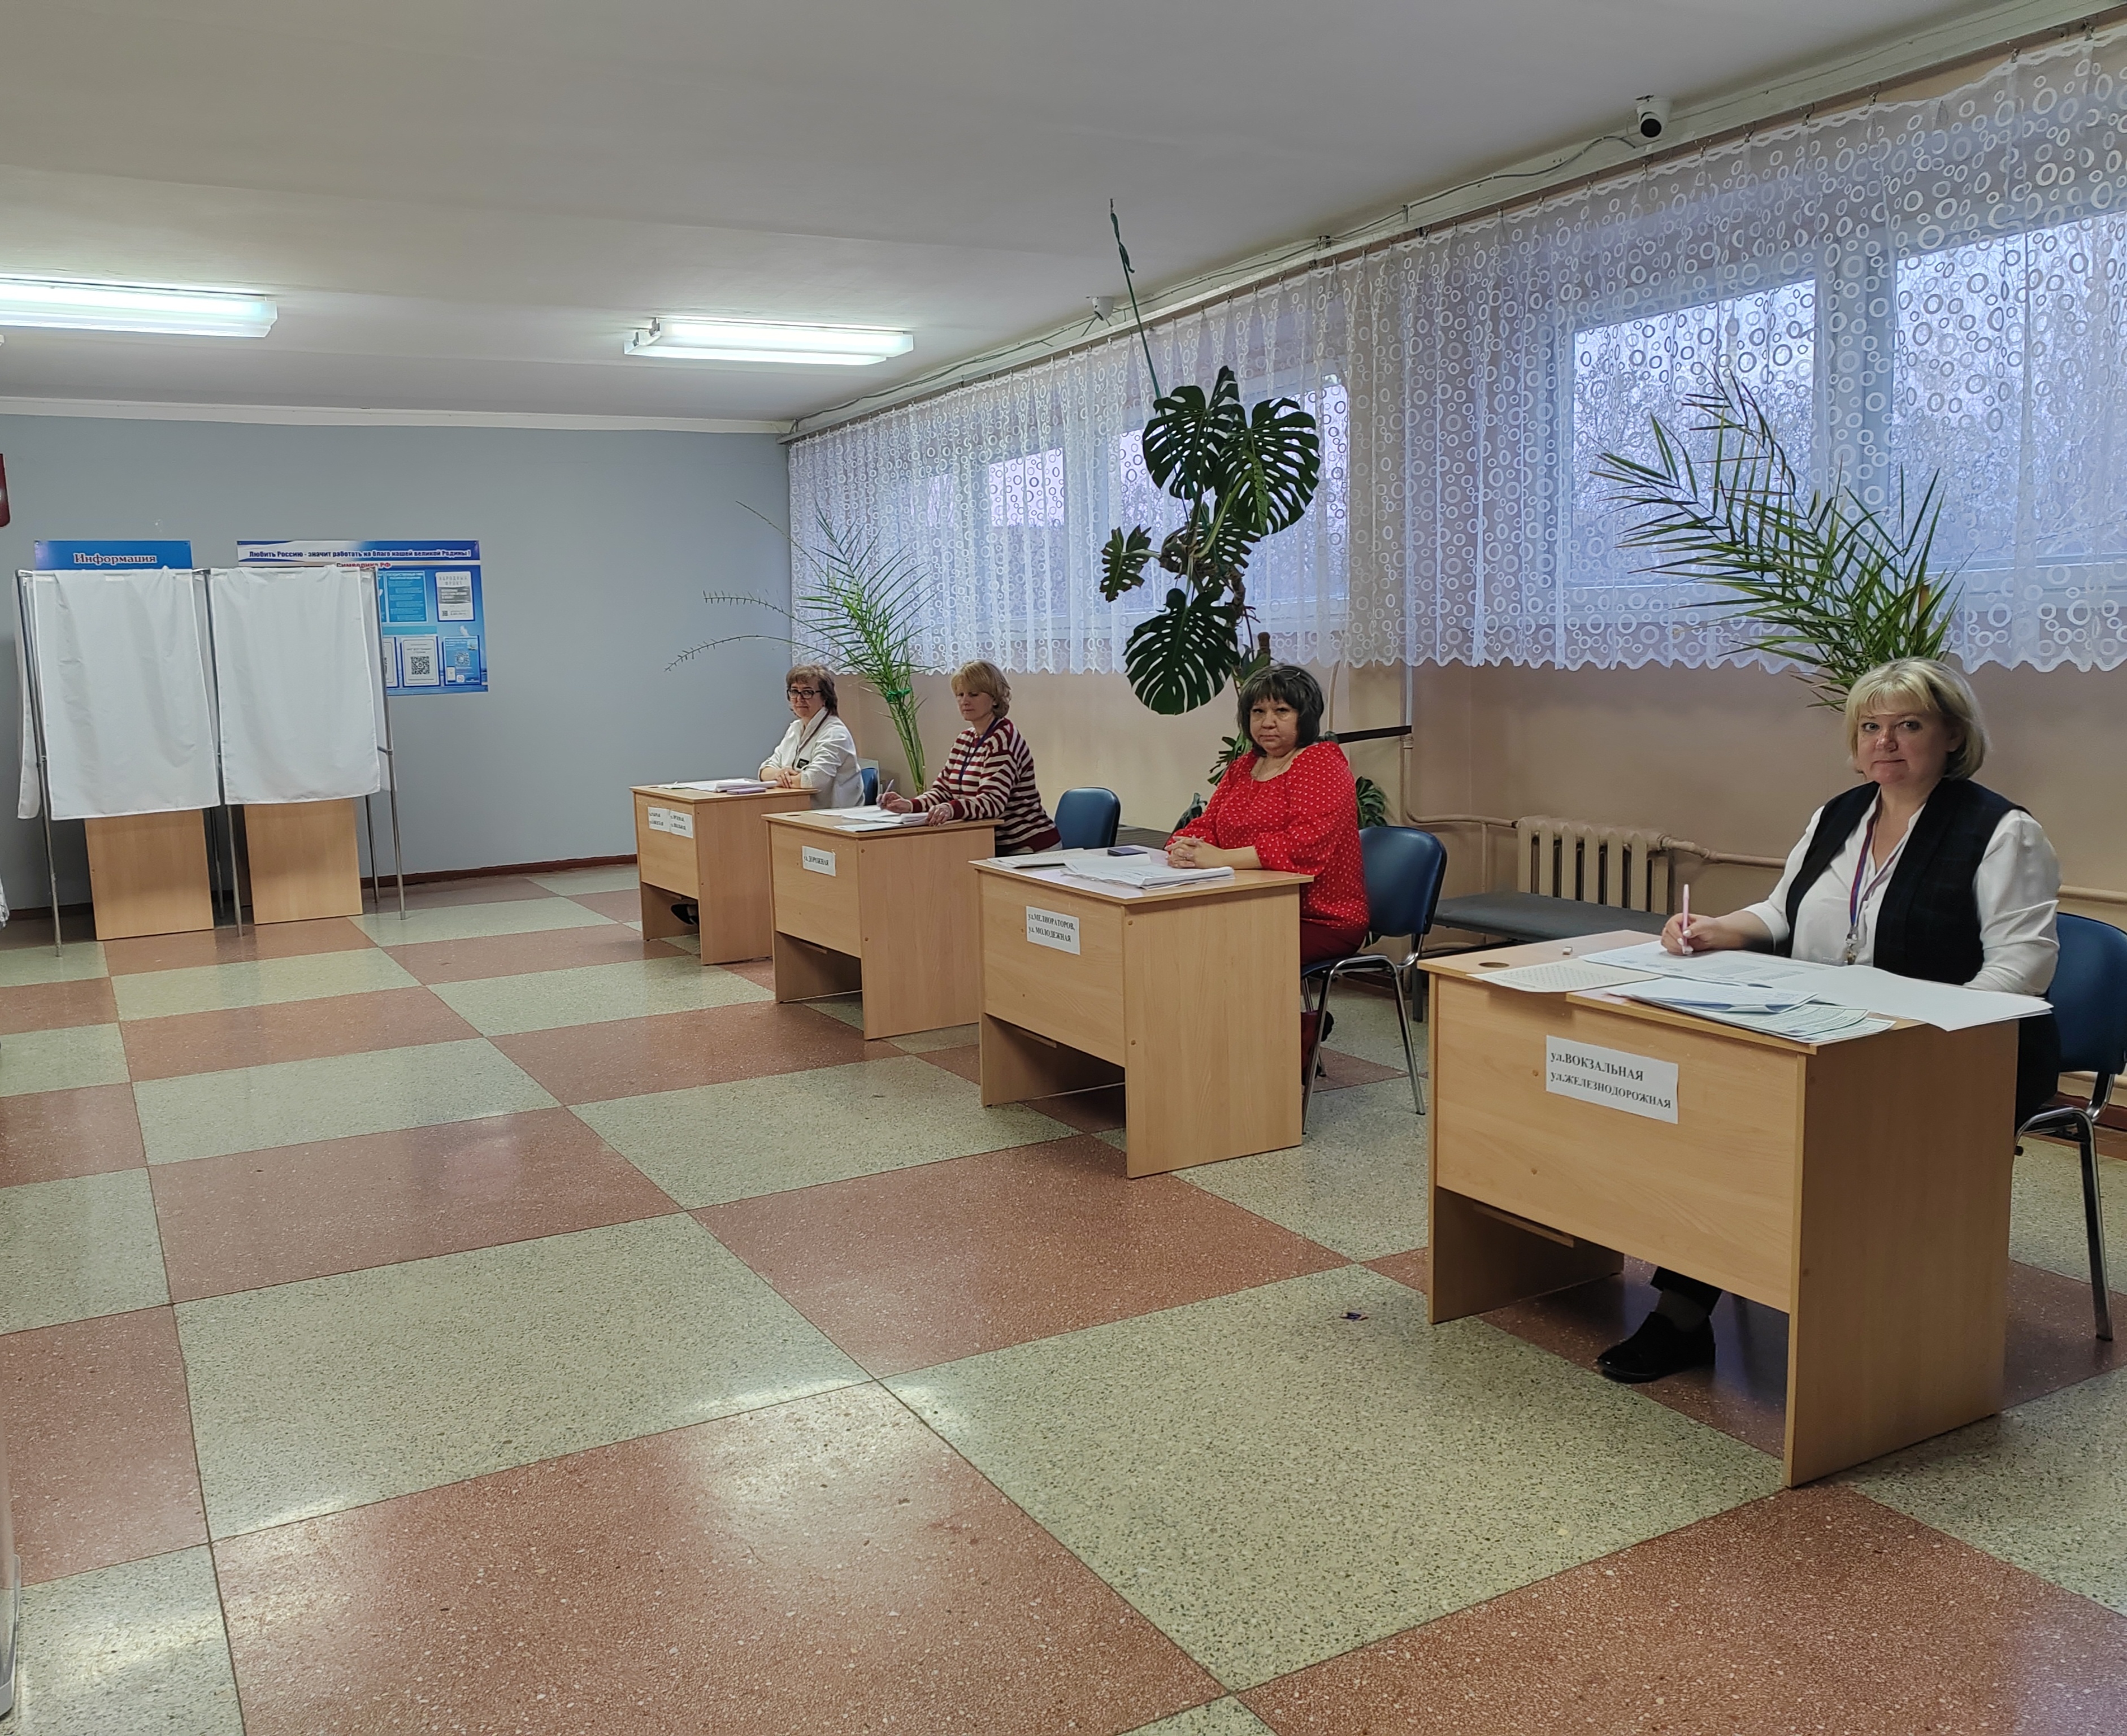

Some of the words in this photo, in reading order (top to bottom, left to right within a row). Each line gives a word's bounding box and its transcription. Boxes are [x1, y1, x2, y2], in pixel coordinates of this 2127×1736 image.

[74, 554, 156, 565] Информация
[1035, 926, 1071, 943] МОЛОДЕЖНАЯ
[1551, 1052, 1643, 1081] ул.ВОКЗАЛЬНАЯ
[1550, 1071, 1672, 1109] ул.ЖЕЛЕЗНОДОРОЖНАЯ
